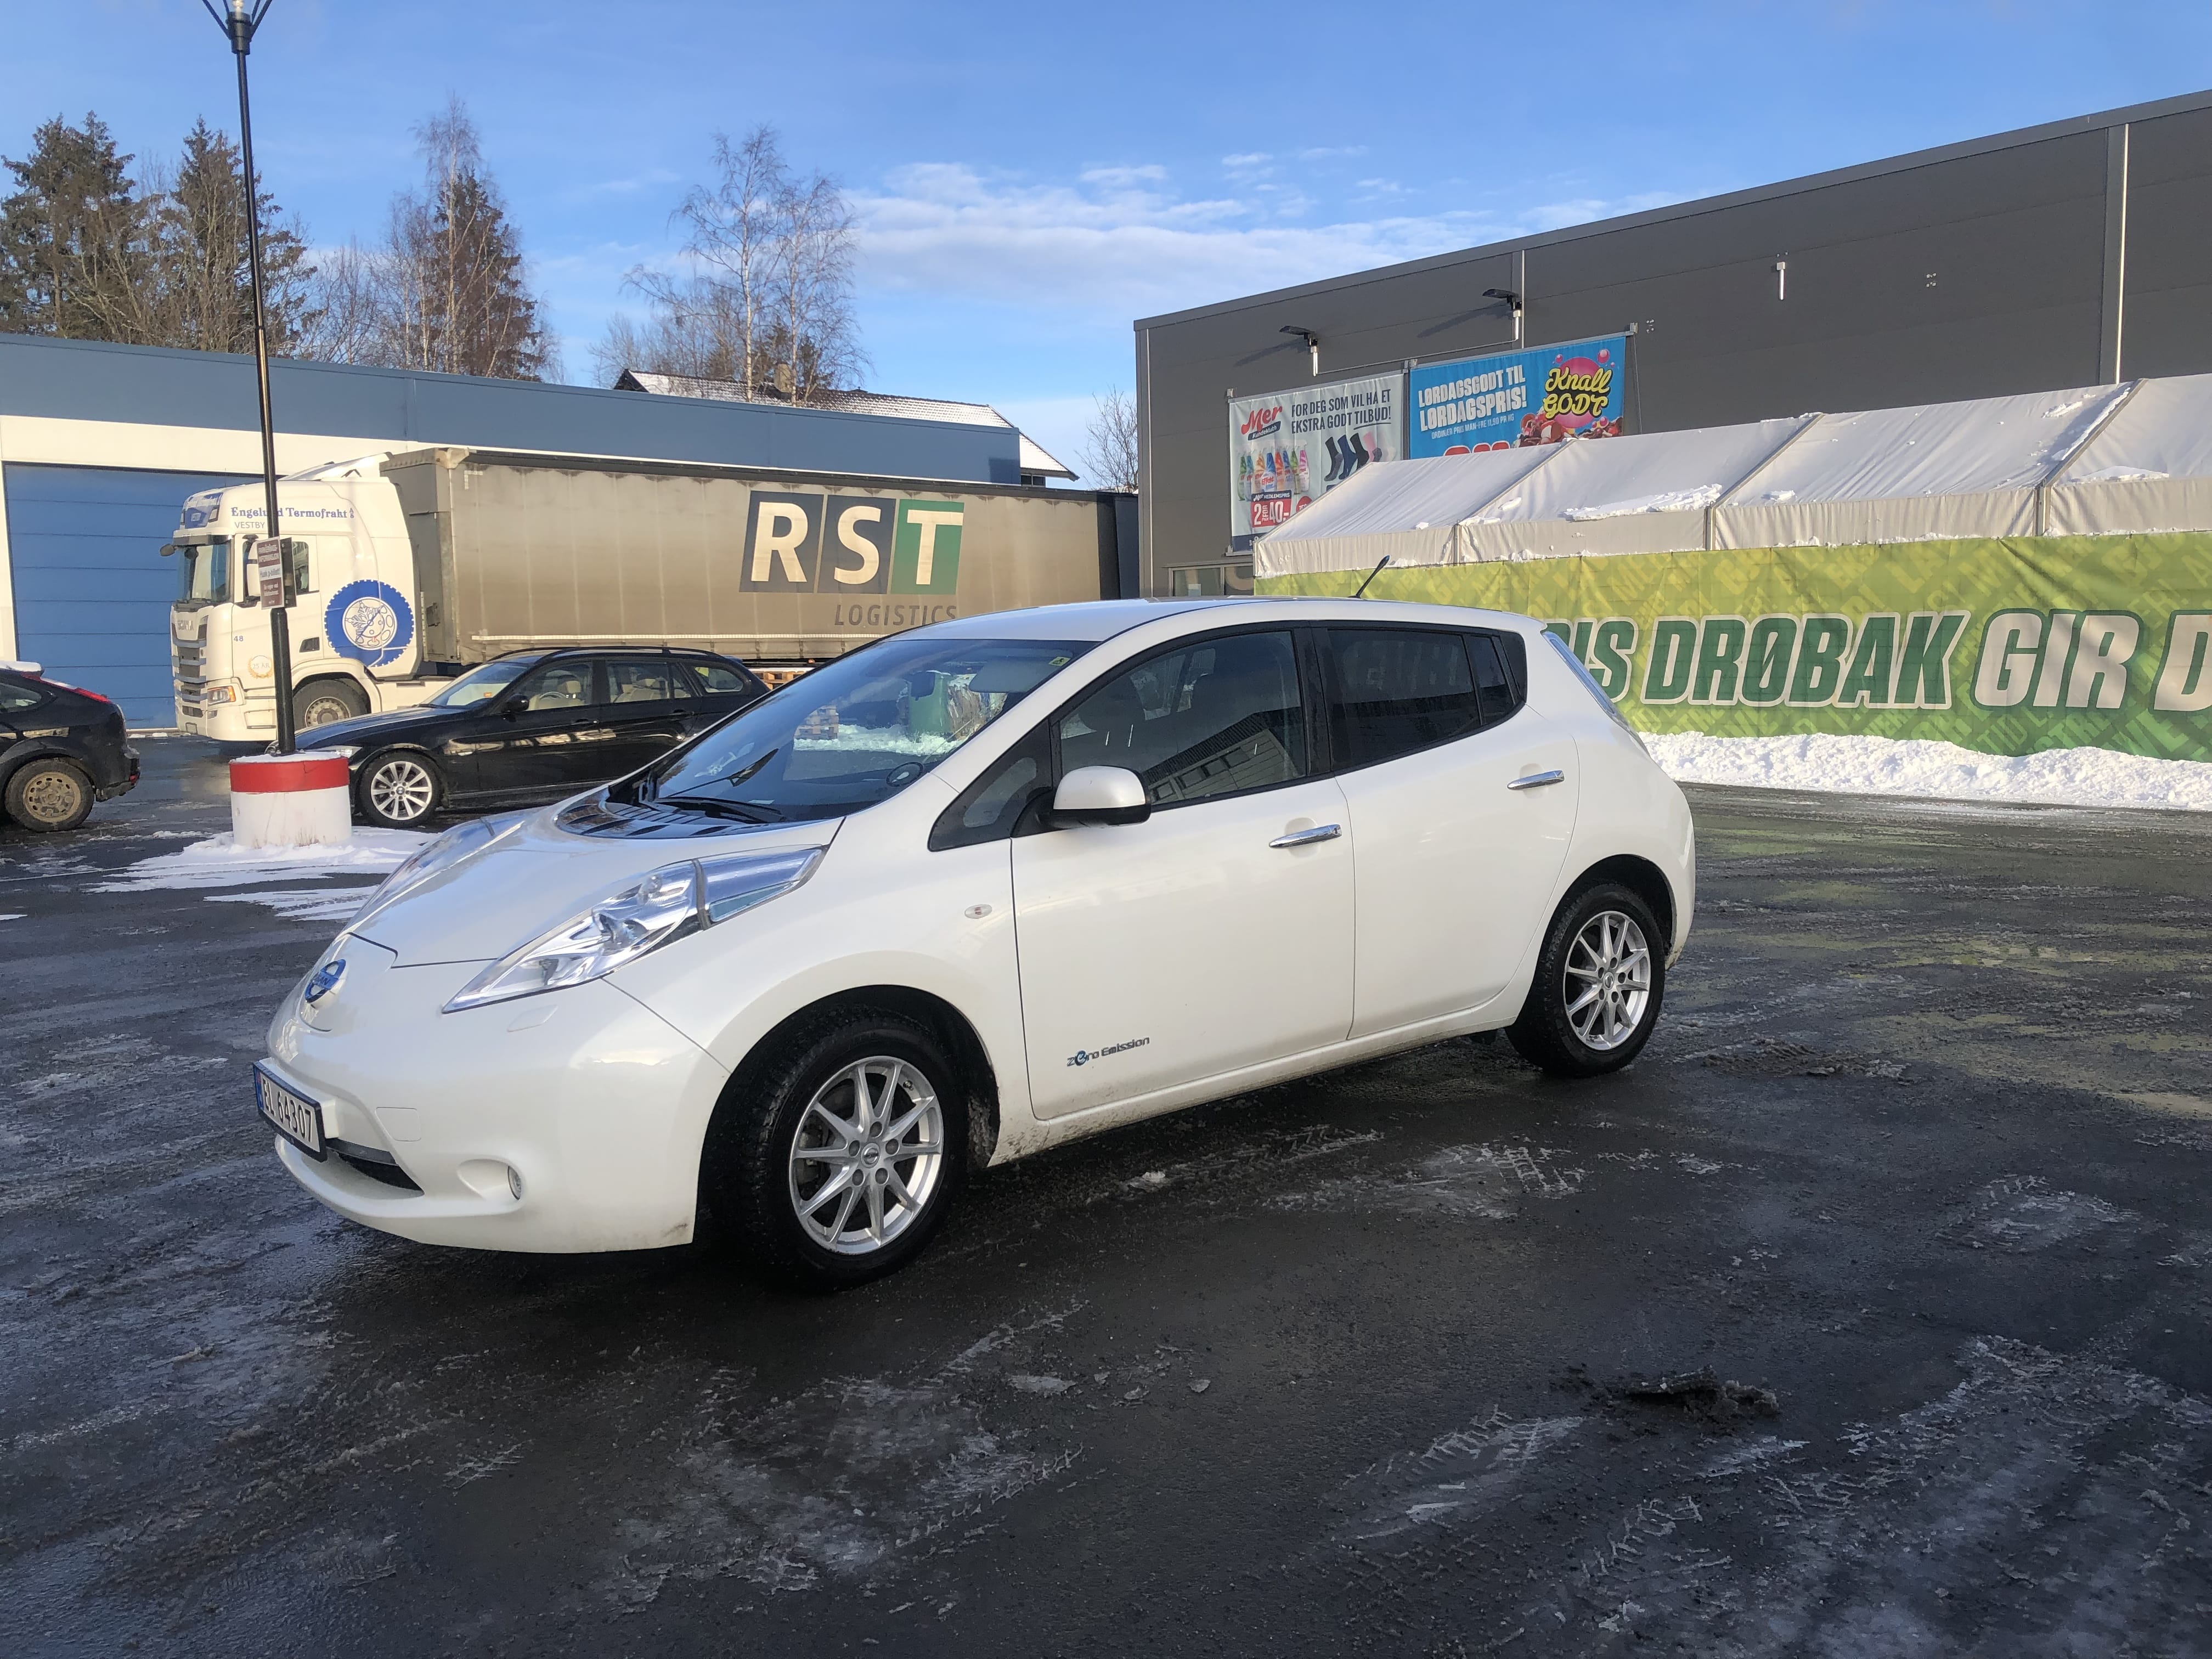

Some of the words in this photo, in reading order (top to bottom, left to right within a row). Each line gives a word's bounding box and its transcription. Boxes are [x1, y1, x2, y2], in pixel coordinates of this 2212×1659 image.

[1418, 370, 1504, 408] LØRDAGSGODT
[1506, 364, 1526, 385] TIL
[1545, 366, 1612, 393] Knall
[1291, 403, 1308, 417] FOR
[1310, 400, 1327, 415] DEG
[1328, 396, 1348, 411] SOM
[1351, 394, 1364, 408] VIL
[1366, 391, 1379, 405] HA
[1381, 389, 1391, 403] ET
[1420, 385, 1527, 432] LØRDAGSPRIS!
[1241, 406, 1283, 435] Mer
[1291, 416, 1325, 434] EKSTRA
[1327, 412, 1353, 427] GODT
[1354, 406, 1391, 425] TILBUD!
[230, 506, 284, 518] Engelud
[285, 507, 347, 518] Termofrakt
[1254, 503, 1261, 526] 2
[751, 500, 964, 585] RST
[834, 604, 957, 626] LOGISTICS
[1641, 611, 1970, 709] DRØBAK
[1973, 610, 2142, 710] GIR
[263, 1078, 275, 1117] EL
[278, 1091, 312, 1143] 64307
